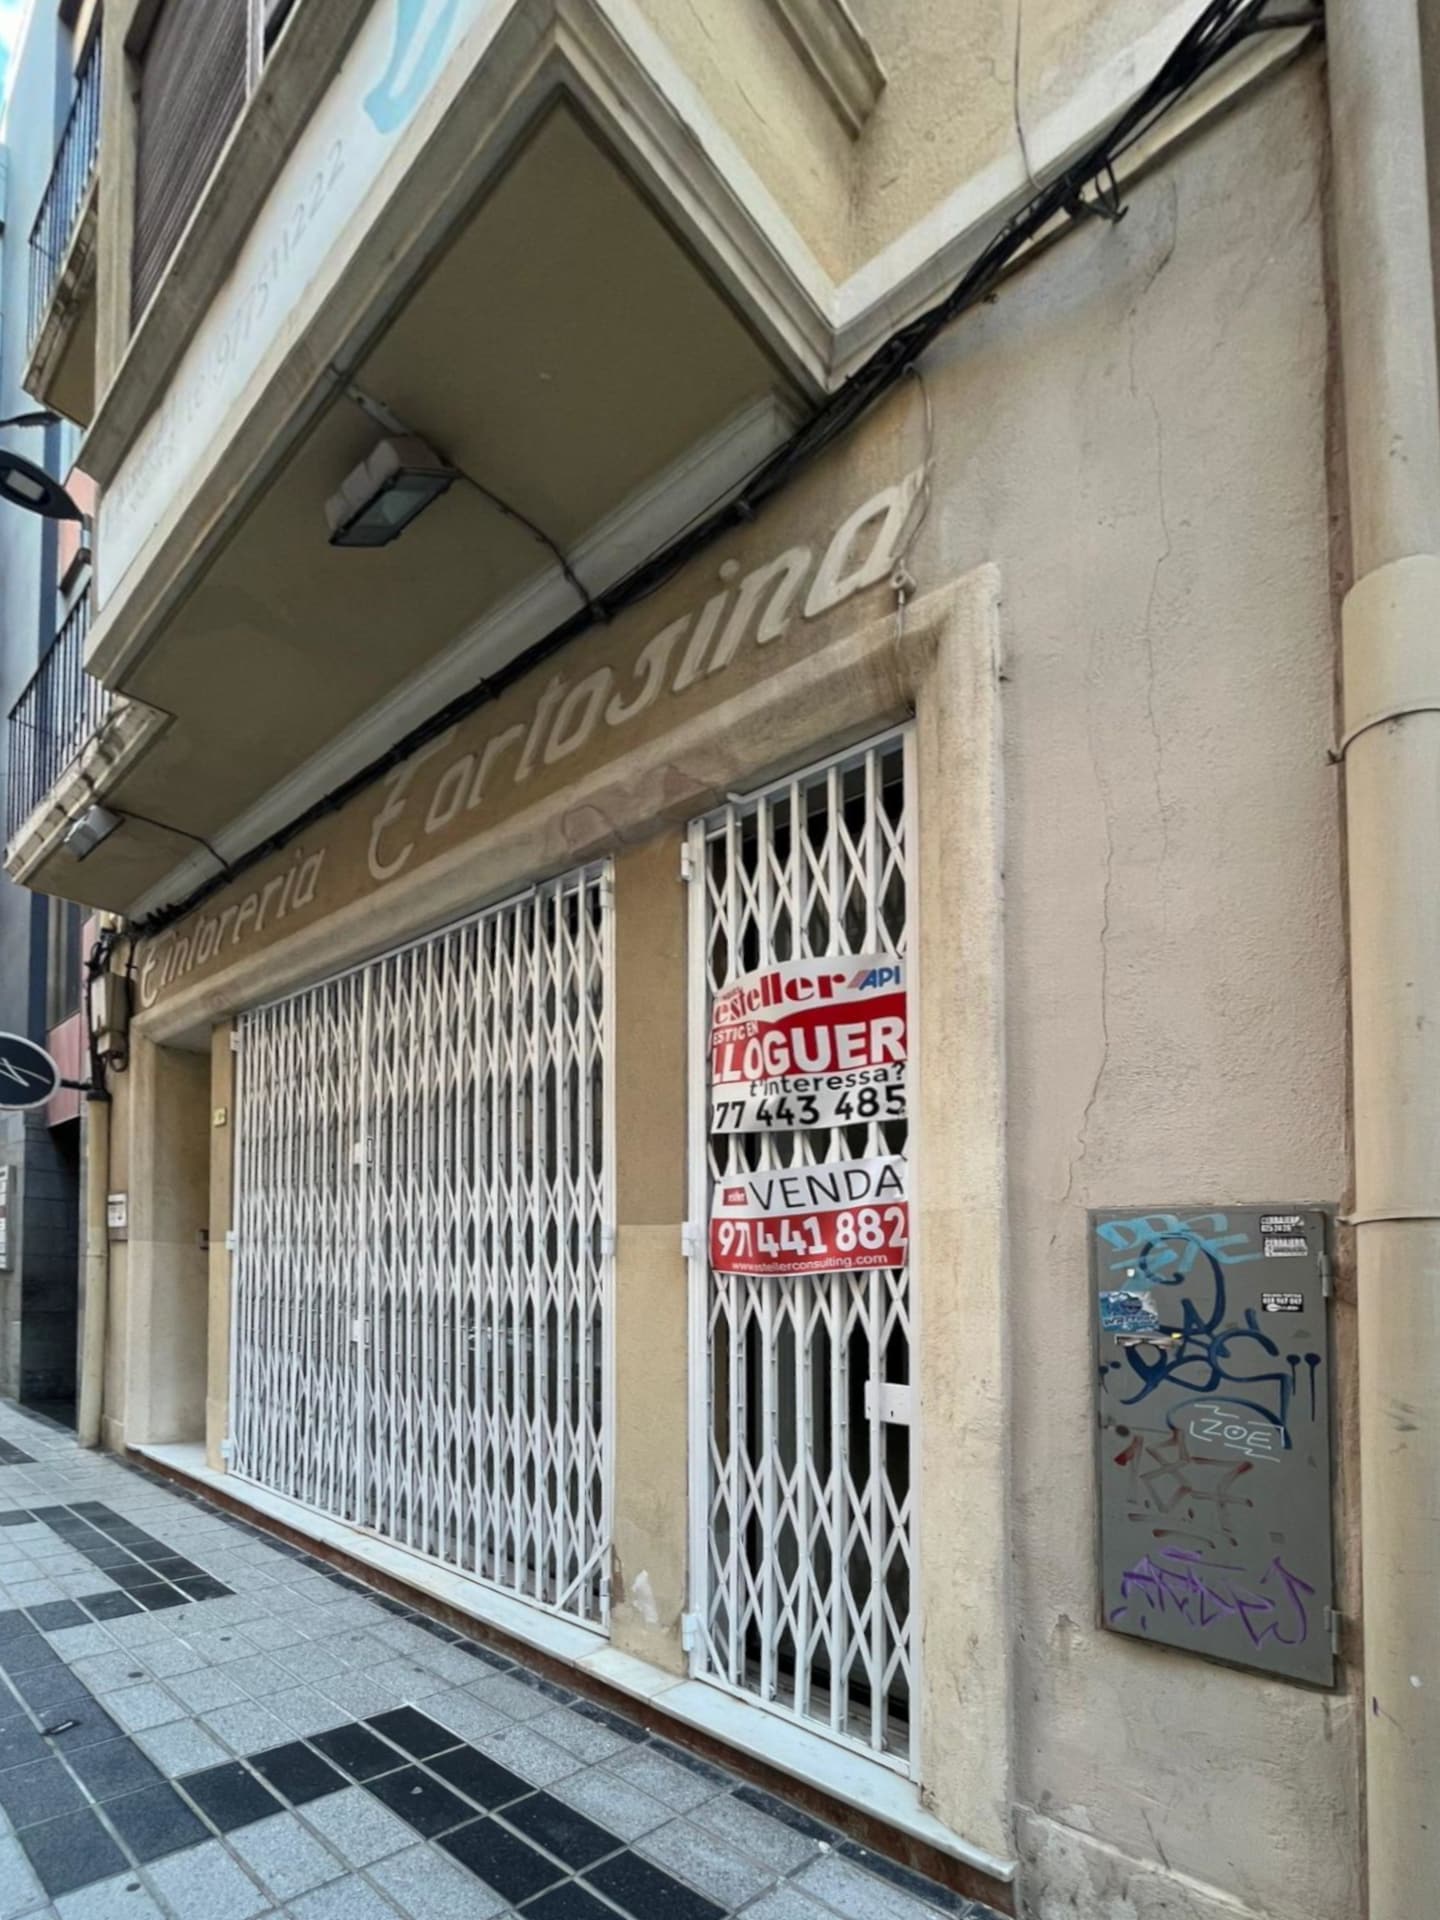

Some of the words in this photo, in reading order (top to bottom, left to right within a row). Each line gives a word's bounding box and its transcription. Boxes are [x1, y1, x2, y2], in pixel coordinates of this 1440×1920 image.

[859, 965, 901, 991] API
[756, 1095, 820, 1127] 443
[834, 1084, 906, 1121] 485
[749, 1164, 904, 1211] VENDA
[757, 1216, 829, 1258] 441
[836, 1206, 908, 1252] 882
[1200, 1417, 1274, 1451] ZOE
